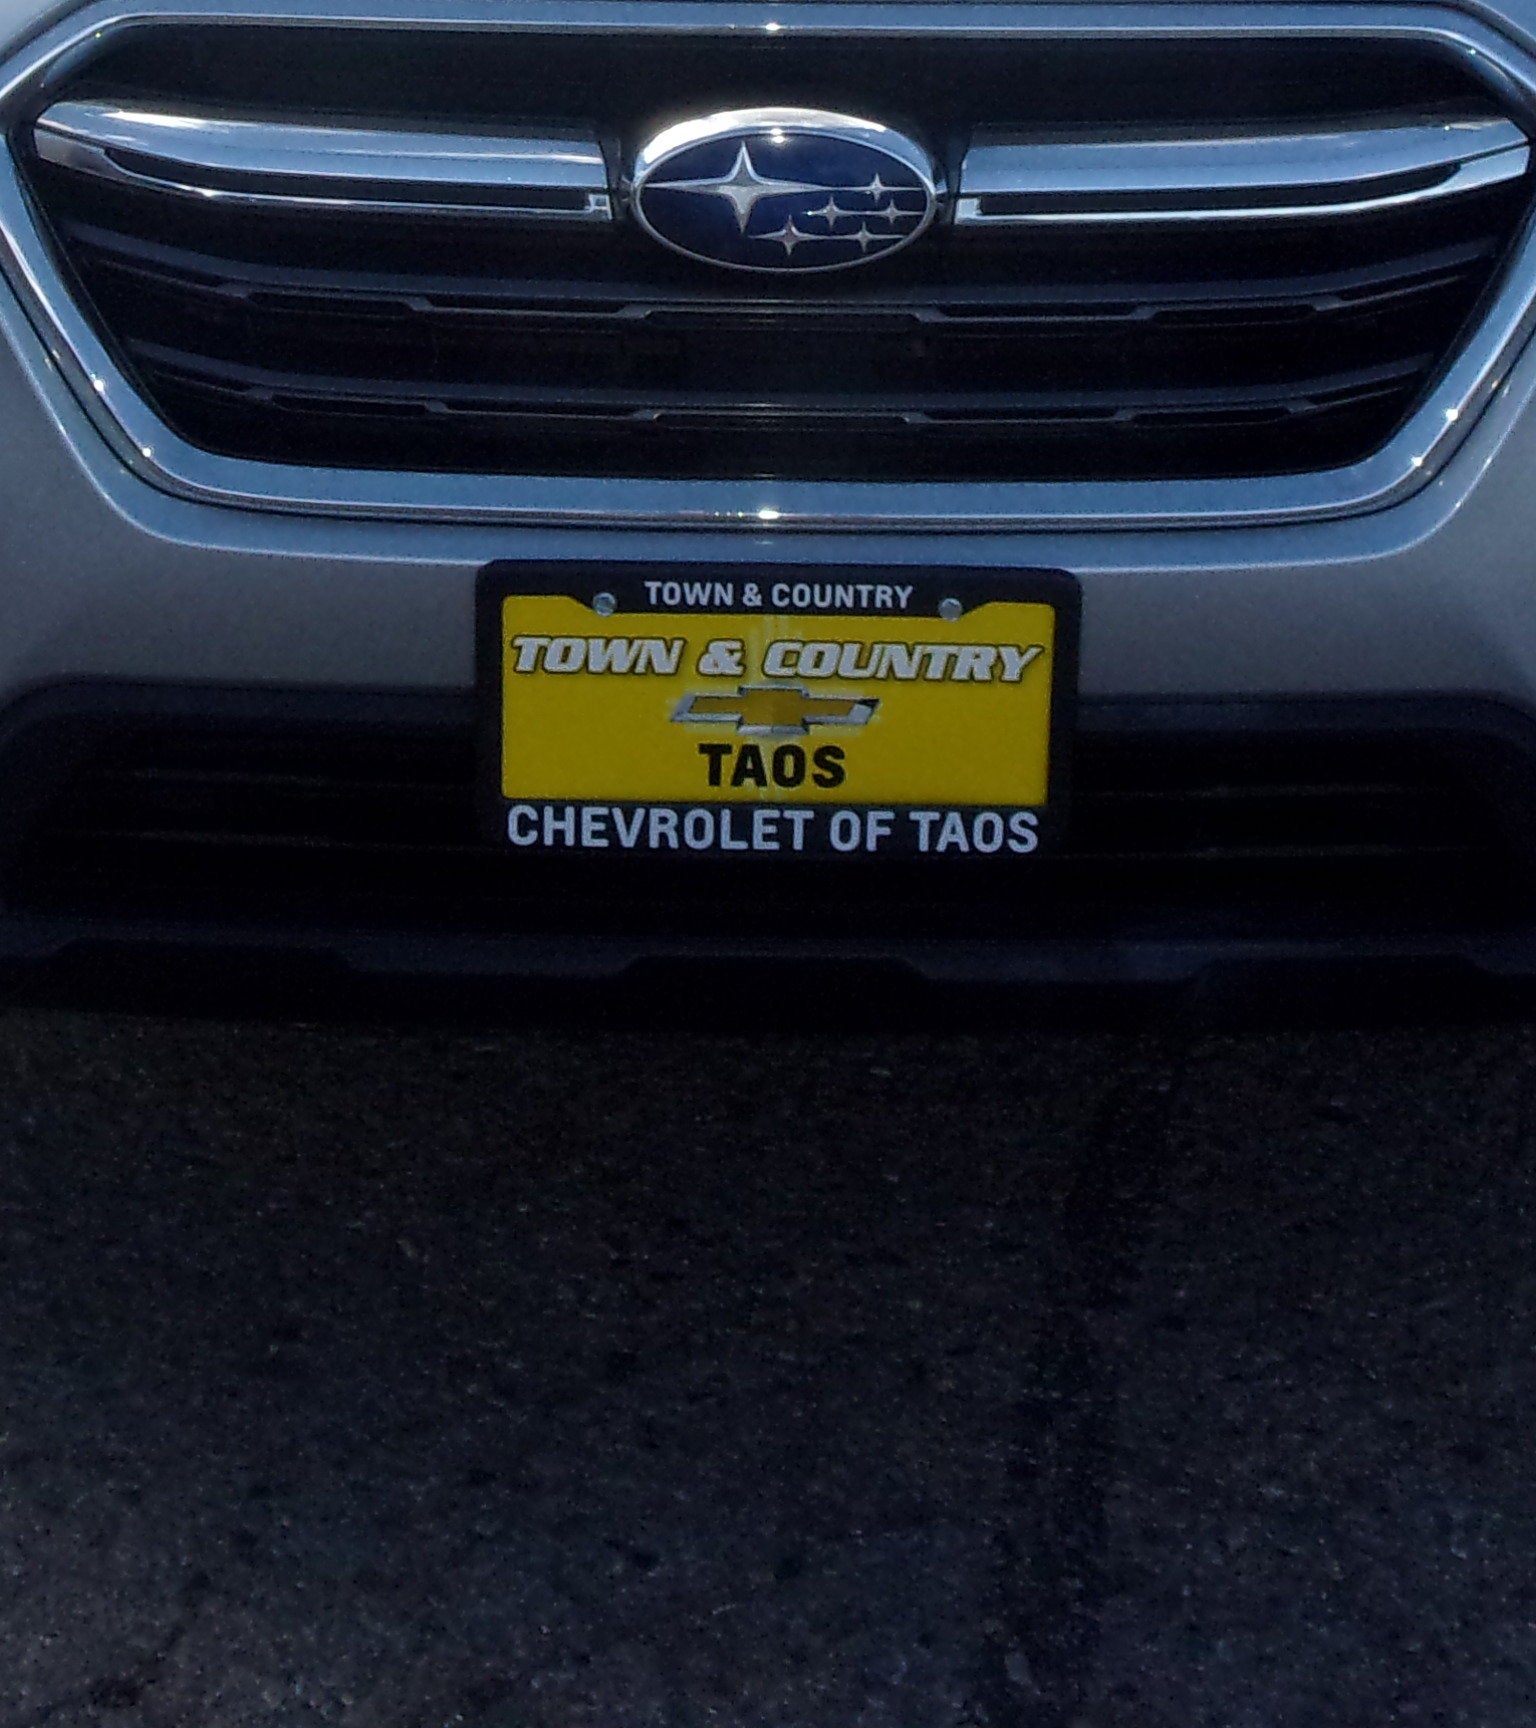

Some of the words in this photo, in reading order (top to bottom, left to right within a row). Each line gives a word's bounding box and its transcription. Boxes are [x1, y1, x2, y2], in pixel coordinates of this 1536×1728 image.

[643, 580, 734, 607] TOWN
[741, 582, 763, 607] &
[771, 582, 914, 609] COUNTRY
[512, 635, 687, 675] TOWN
[697, 638, 746, 677] &
[762, 638, 1046, 683] COUNTRY
[697, 742, 847, 789] TAOS
[506, 803, 815, 852] CHEVROLET
[828, 809, 896, 852] OF
[908, 810, 1040, 854] TAOS
